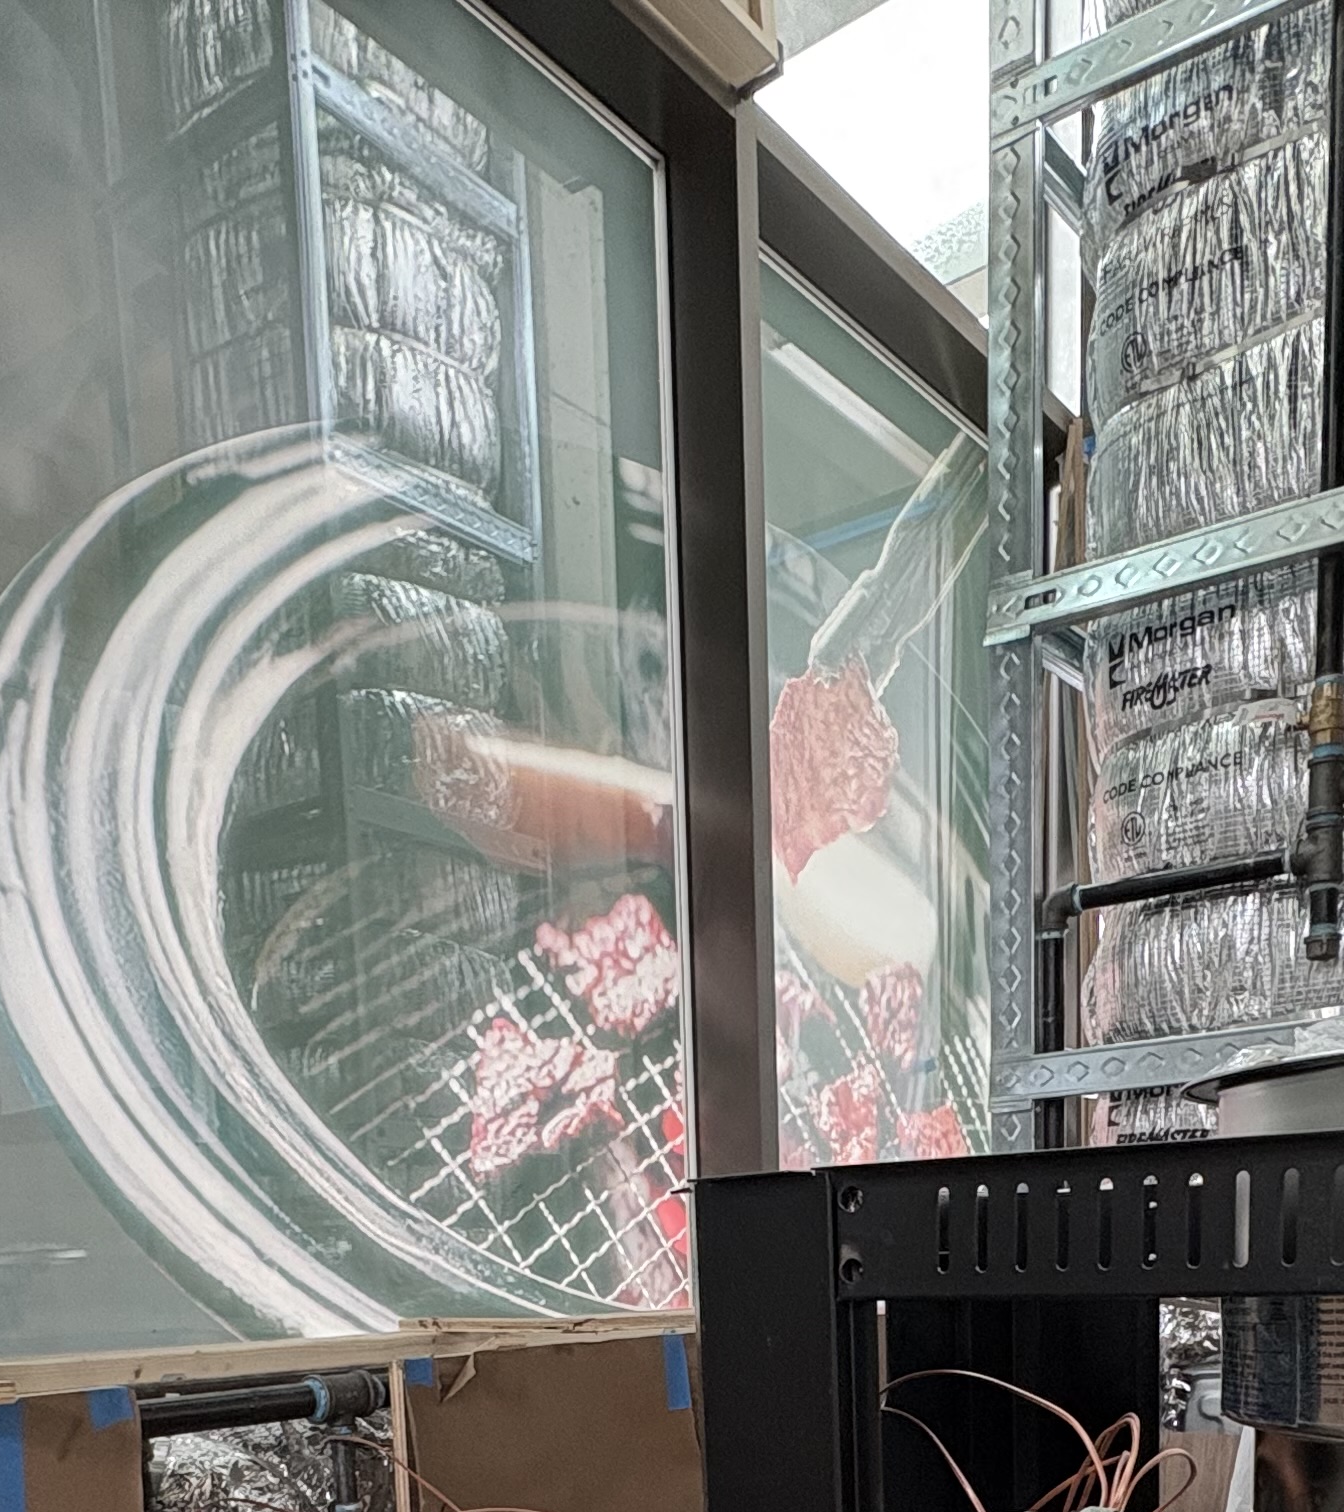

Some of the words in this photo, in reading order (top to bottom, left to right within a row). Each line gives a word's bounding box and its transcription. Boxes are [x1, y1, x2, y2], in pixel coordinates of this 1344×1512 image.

[1124, 84, 1234, 161] Morgan
[1128, 603, 1236, 653] Morgan
[1103, 779, 1137, 804] CODE
